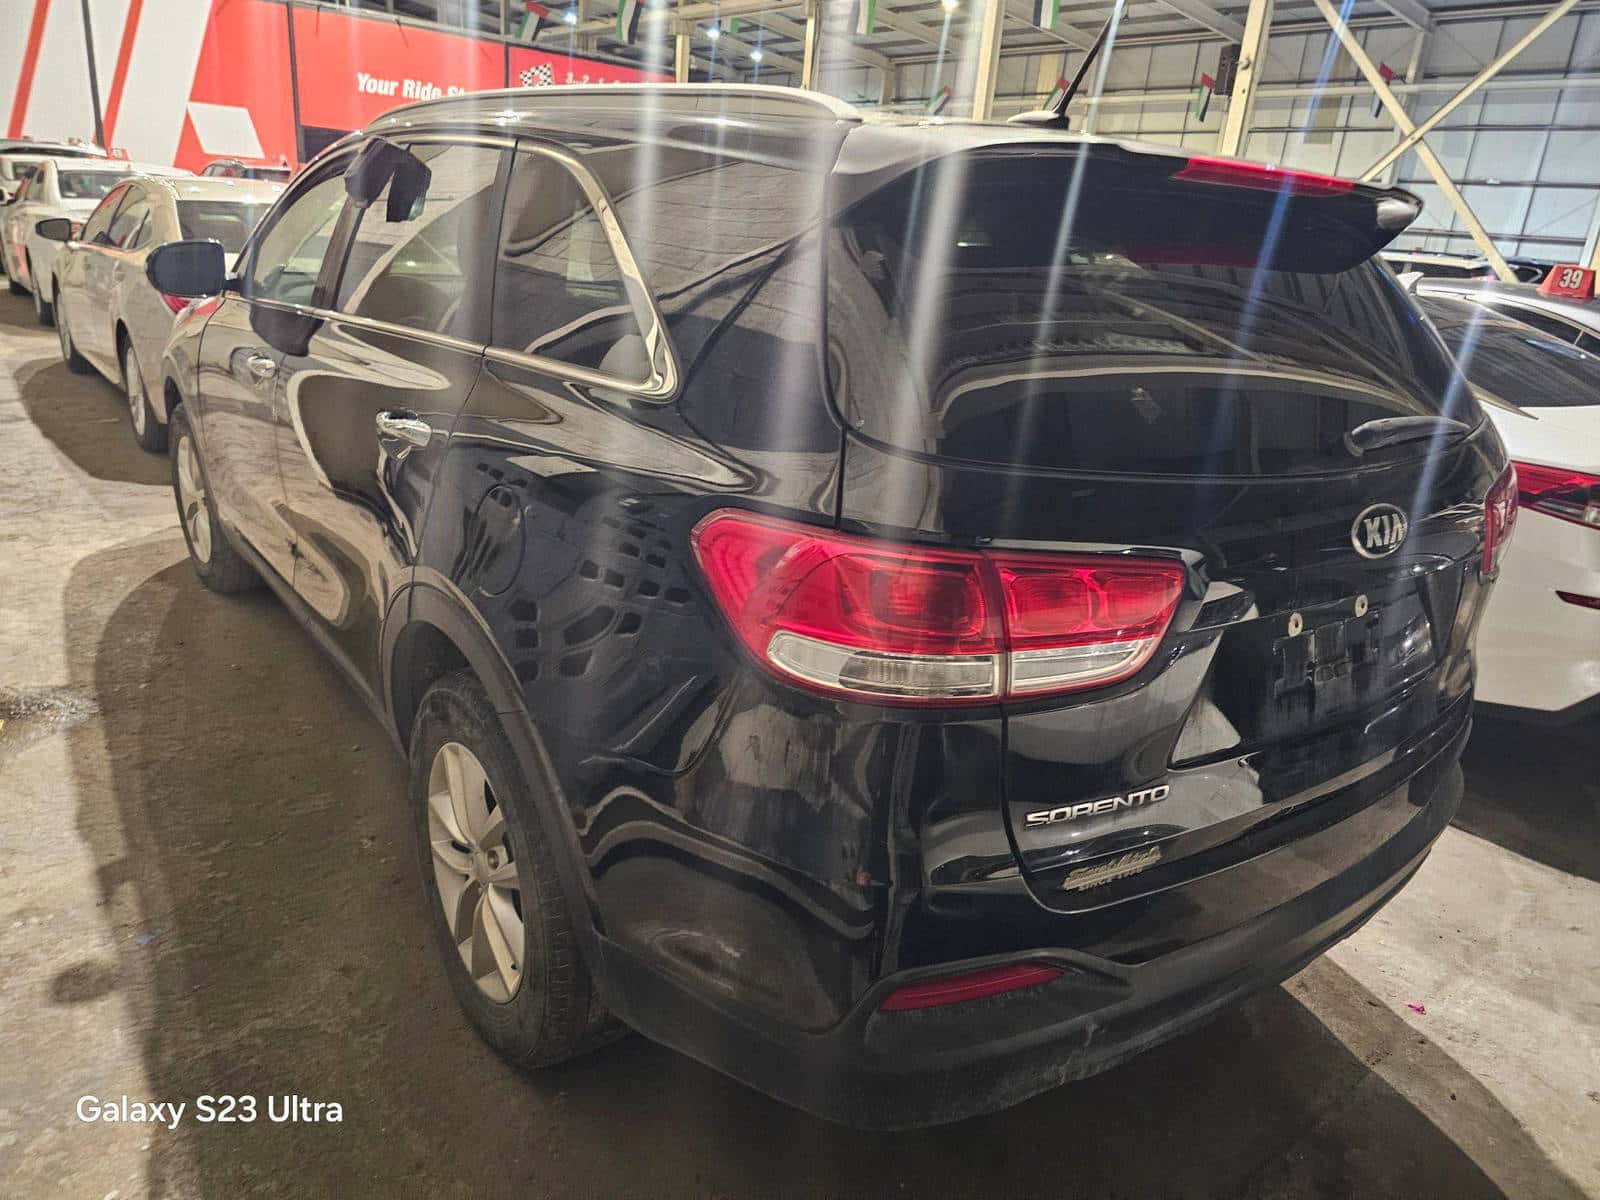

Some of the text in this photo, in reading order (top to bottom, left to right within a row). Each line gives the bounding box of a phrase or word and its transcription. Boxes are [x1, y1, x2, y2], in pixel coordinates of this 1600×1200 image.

[357, 72, 399, 96] Your
[402, 79, 442, 100] Ride
[1559, 268, 1584, 289] 39
[1362, 512, 1404, 549] KIA
[1026, 785, 1170, 827] SORENTO
